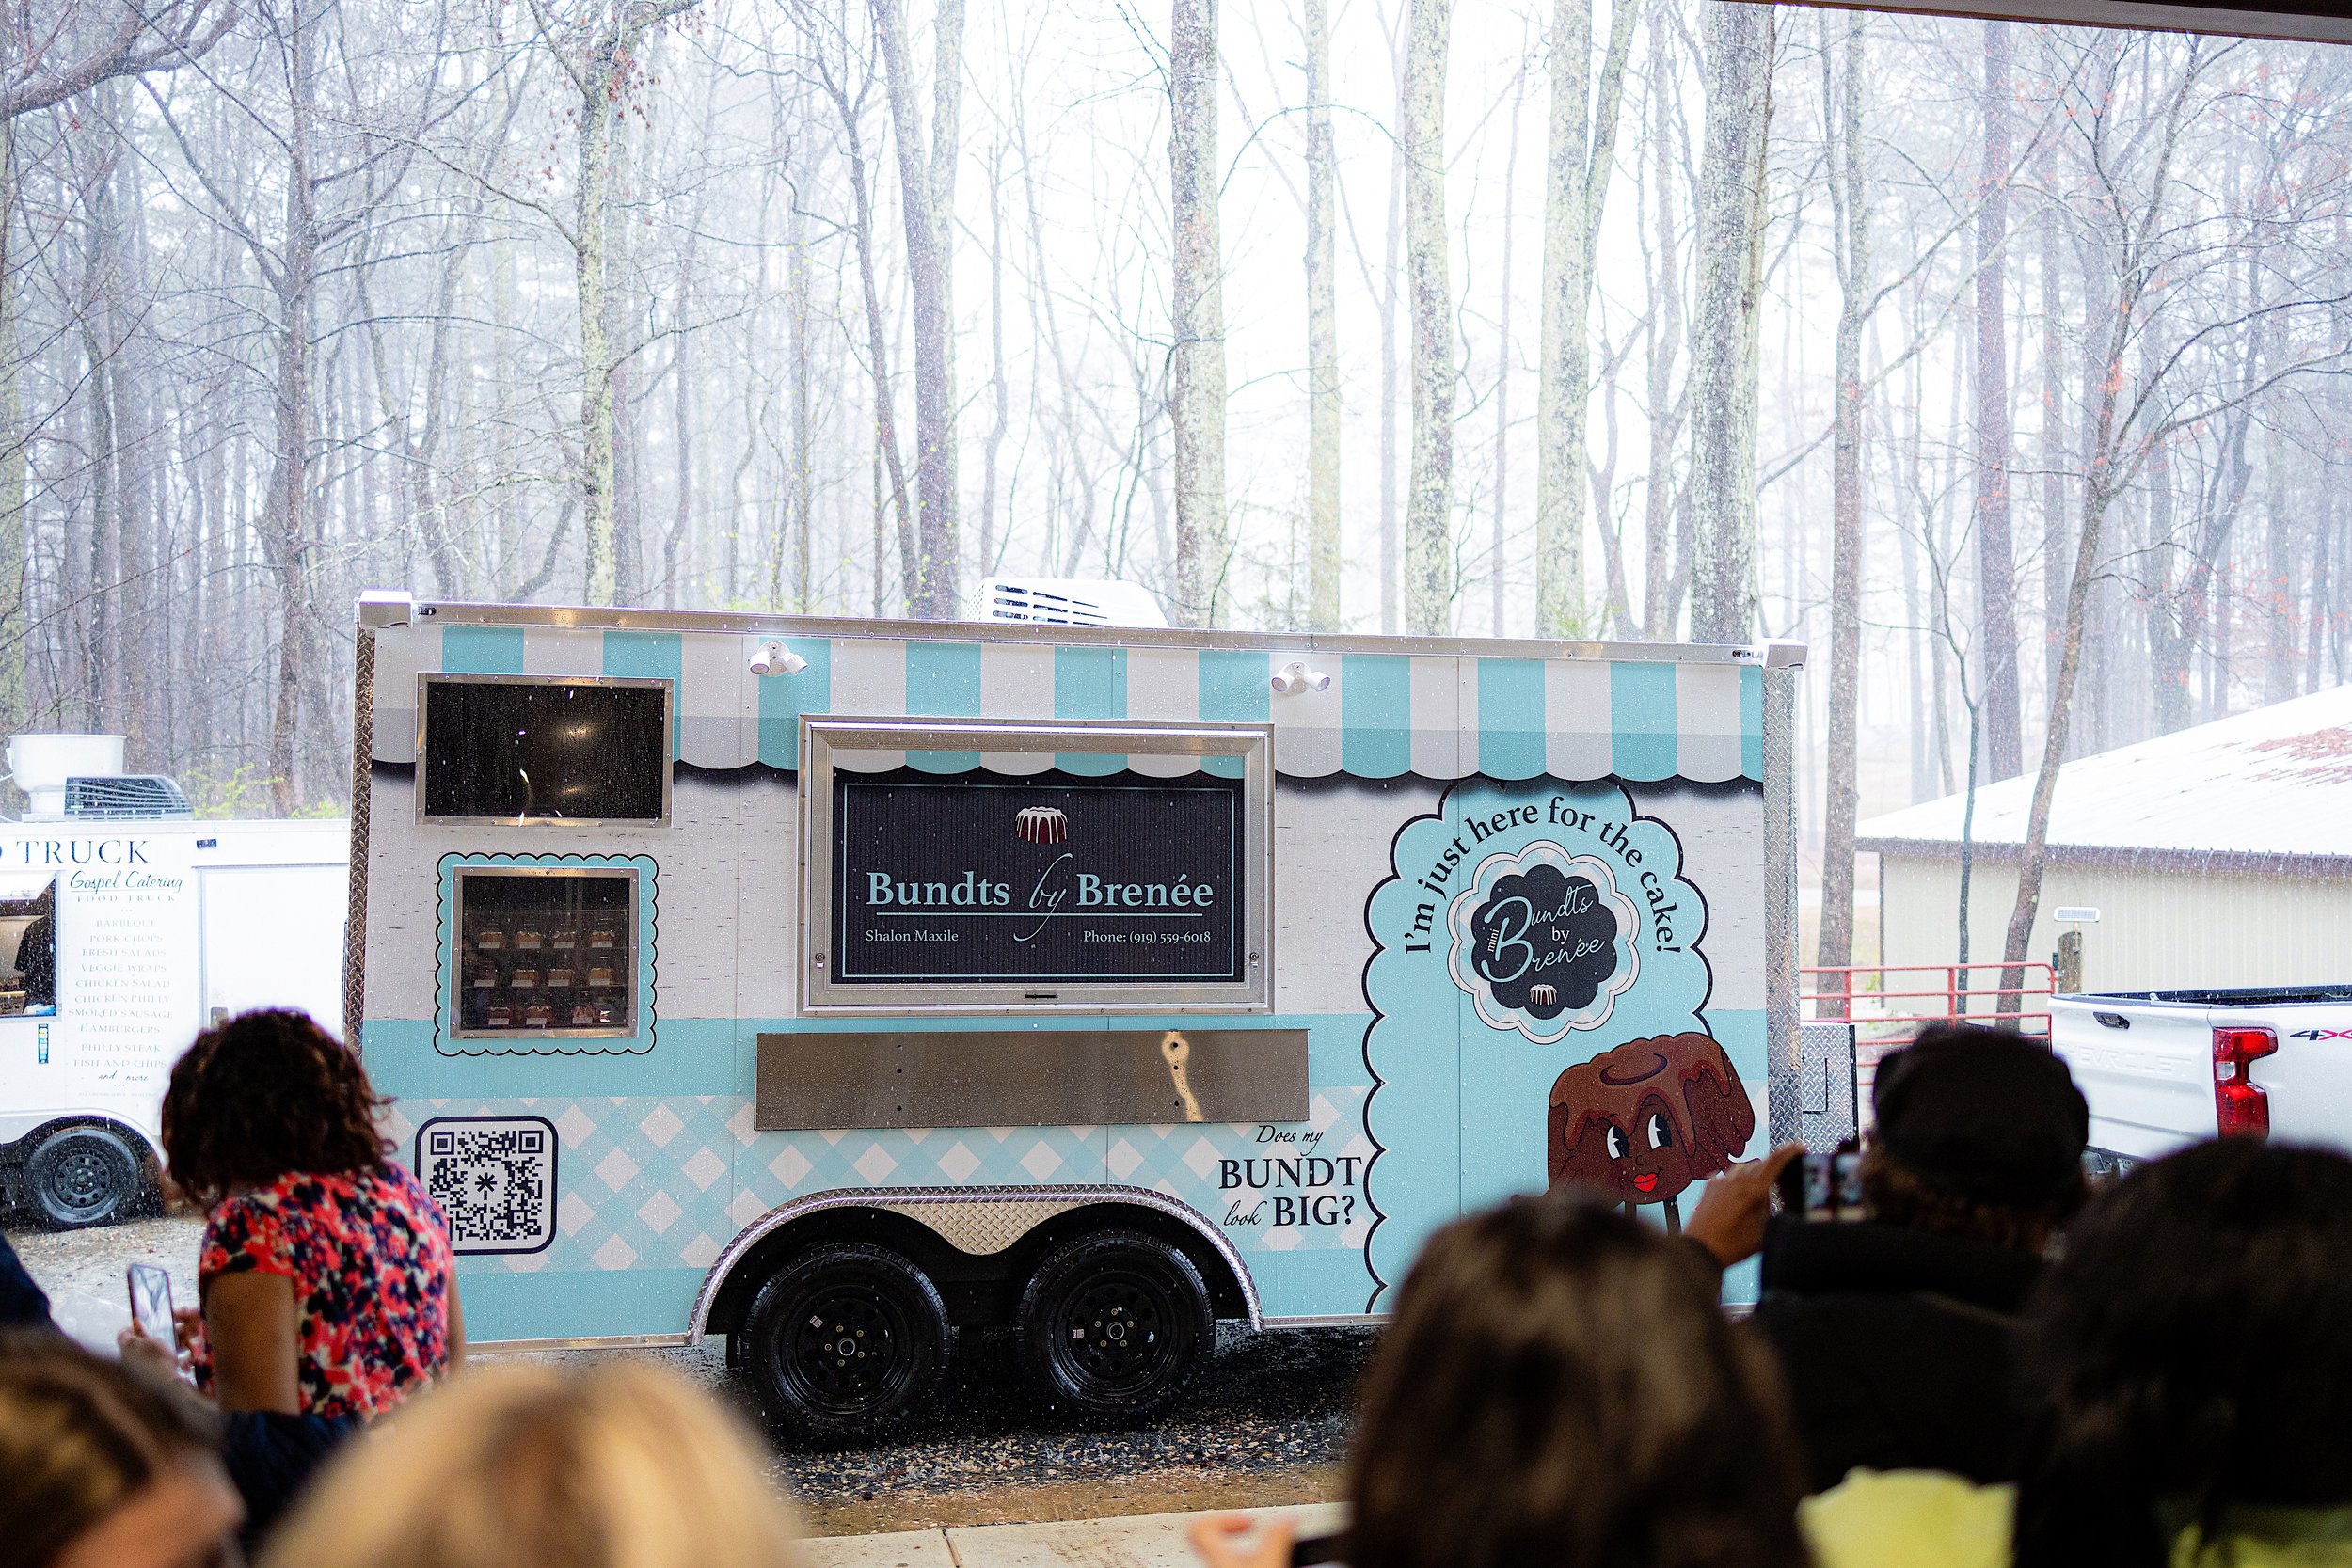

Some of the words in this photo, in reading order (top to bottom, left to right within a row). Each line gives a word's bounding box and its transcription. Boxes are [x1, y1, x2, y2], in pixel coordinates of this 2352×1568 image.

[1464, 804, 1539, 845] here
[1548, 796, 1596, 832] for
[16, 840, 151, 863] TRUCK
[1599, 821, 1643, 868] the
[1417, 836, 1470, 900] just
[70, 870, 122, 895] Gospel
[125, 870, 183, 893] Catering
[866, 870, 1010, 906] Bundts
[1013, 852, 1073, 942] by
[1076, 873, 1214, 907] Brenée
[1640, 871, 1681, 953] cake!
[89, 934, 120, 942] PORK
[124, 934, 163, 942] CHOPS
[866, 929, 911, 942] Shalon
[914, 929, 959, 942] Maxile
[1083, 930, 1127, 942] Phone:
[1129, 930, 1157, 944] (919)
[1160, 930, 1211, 944] 559-6018
[1404, 903, 1436, 954] I'm
[1487, 927, 1500, 953] mini
[1550, 926, 1570, 945] by
[121, 948, 167, 957] SALADS
[75, 979, 129, 988] CHICKEN
[132, 979, 170, 988] SALAD
[131, 995, 170, 1004] PHILLY
[120, 1009, 173, 1019] SAUSAGE
[80, 1024, 161, 1034] HAMBURGERS
[81, 1043, 121, 1052] PHILLY
[124, 1044, 162, 1053] STEAK
[73, 1059, 100, 1068] FISH
[103, 1059, 131, 1068] AND
[134, 1060, 167, 1069] CHIPS
[98, 1069, 119, 1080] and
[1255, 1125, 1296, 1143] Does
[1300, 1132, 1324, 1157] my
[1218, 1156, 1362, 1189] BUNDT
[1223, 1199, 1268, 1227] look
[1272, 1195, 1355, 1227] BIG?
